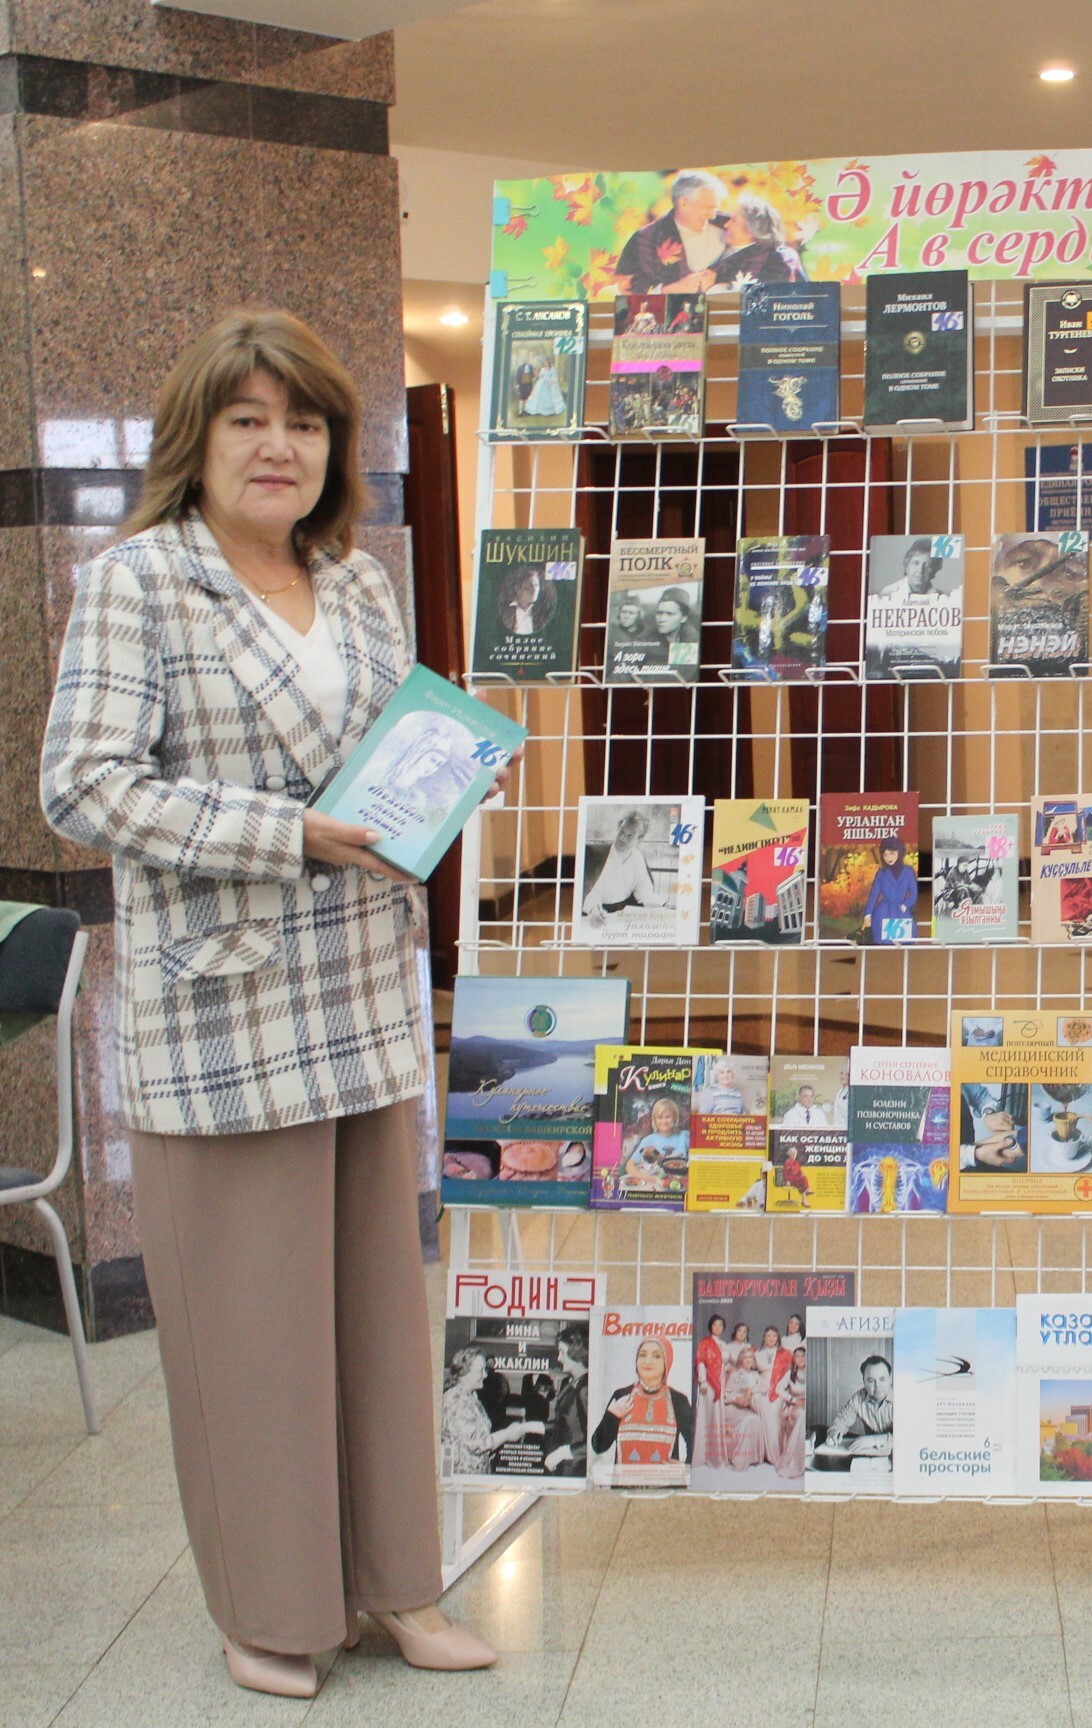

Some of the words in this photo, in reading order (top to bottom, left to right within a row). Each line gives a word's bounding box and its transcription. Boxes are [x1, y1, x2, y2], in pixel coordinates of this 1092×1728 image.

[827, 170, 871, 221] Ә
[858, 223, 899, 269] А
[921, 234, 949, 267] в
[897, 293, 933, 301] Михаил
[773, 302, 815, 311] Николай
[883, 302, 947, 314] ЛЕРМОНТОВ
[533, 311, 572, 320] АКСАКОВ
[773, 312, 814, 321] ГОГОЛЬ
[1060, 320, 1082, 329] Иван
[1055, 366, 1085, 375] ЗАПИСКИ
[1051, 374, 1088, 382] ОХОТНИКА
[486, 542, 574, 566] ШУКШИН
[620, 544, 699, 556] БЕССМЕРТНЫЙ
[619, 557, 673, 572] ПОЛК
[872, 607, 961, 629] НЕКРАСОВ
[614, 651, 623, 663] А
[624, 652, 645, 664] зори
[613, 663, 638, 674] здесь
[837, 815, 905, 828] УРЛАНГАН
[843, 827, 898, 840] ЯШЬЛЕК
[651, 1056, 674, 1065] Дарья
[873, 1061, 898, 1069] СЕРГЕЙ
[900, 1061, 937, 1069] СЕРГЕЕВИЧ
[860, 1069, 950, 1081] КОНОВАЛОВ
[873, 1100, 906, 1108] БОЛЕЗНИ
[857, 1110, 921, 1120] ПОЗВОНОЧНИКА
[873, 1122, 911, 1130] СУСТАВОВ
[808, 1155, 821, 1163] ДО
[824, 1154, 841, 1162] 100
[455, 1275, 595, 1317] РОДИНА
[506, 1325, 540, 1338] НИНА
[518, 1342, 526, 1352] И
[494, 1358, 549, 1370] ЖАКЛИН
[984, 1437, 990, 1448] 6
[919, 1448, 991, 1461] бельские
[919, 1462, 991, 1476] просторы
